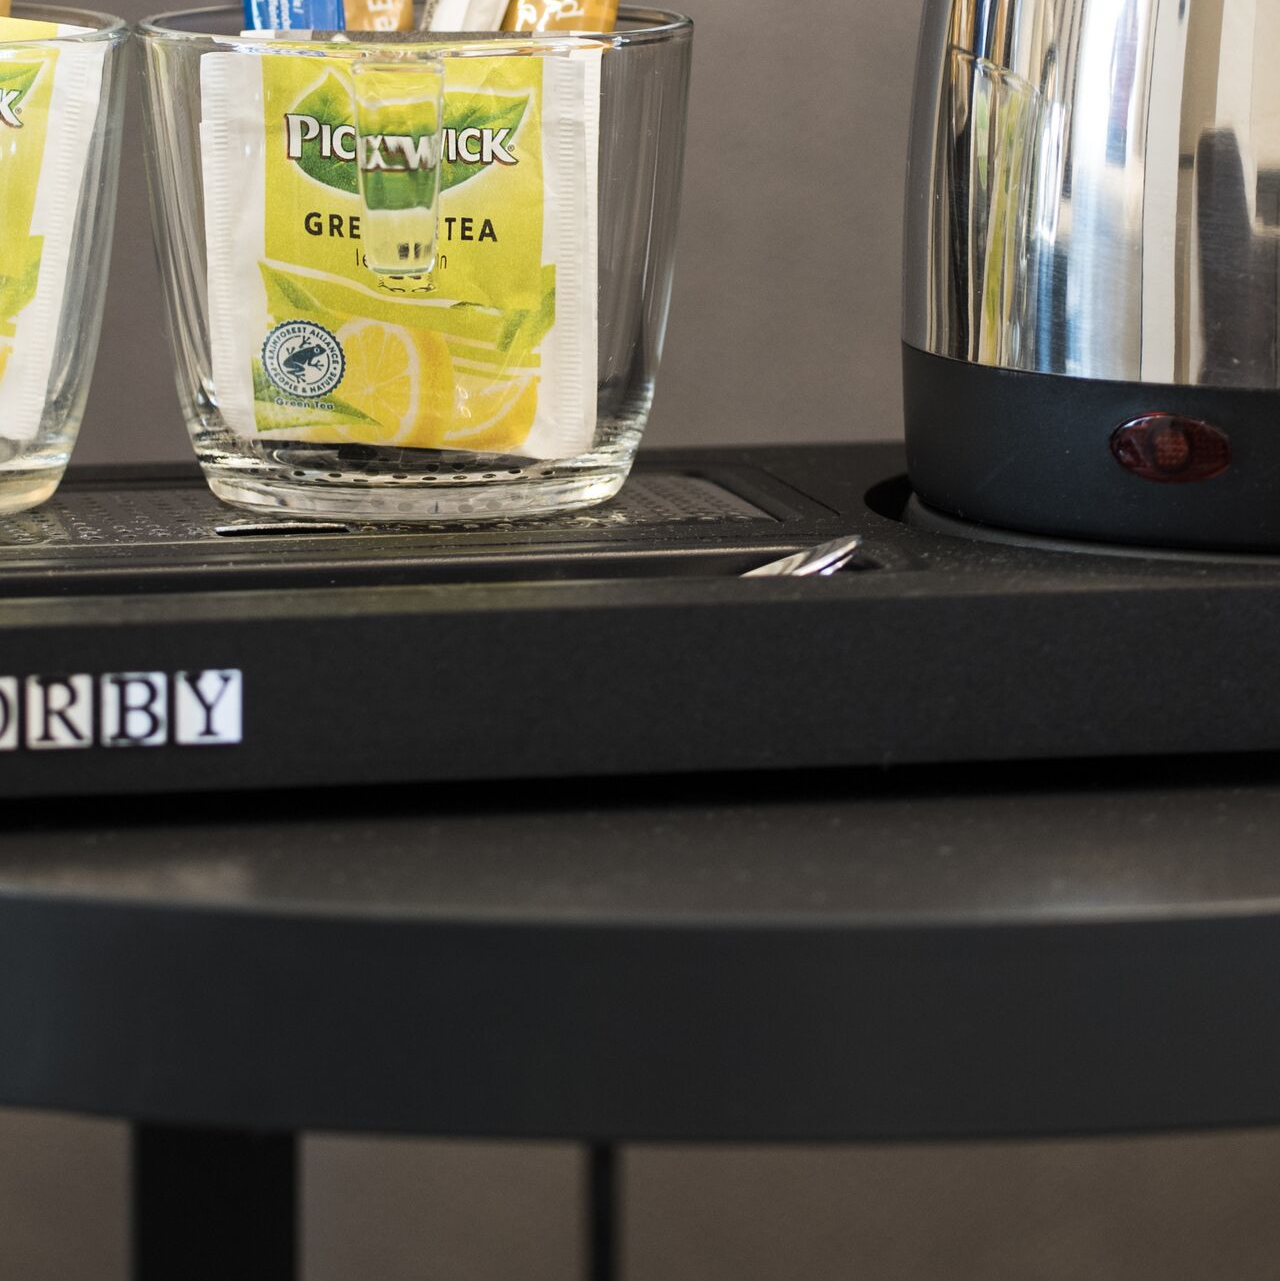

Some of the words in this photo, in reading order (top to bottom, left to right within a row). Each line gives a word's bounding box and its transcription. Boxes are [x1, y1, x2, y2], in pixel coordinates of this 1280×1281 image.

[444, 217, 499, 243] TEA
[309, 328, 340, 365] ALLIANCE
[275, 397, 311, 408] Green
[314, 400, 334, 411] Tea
